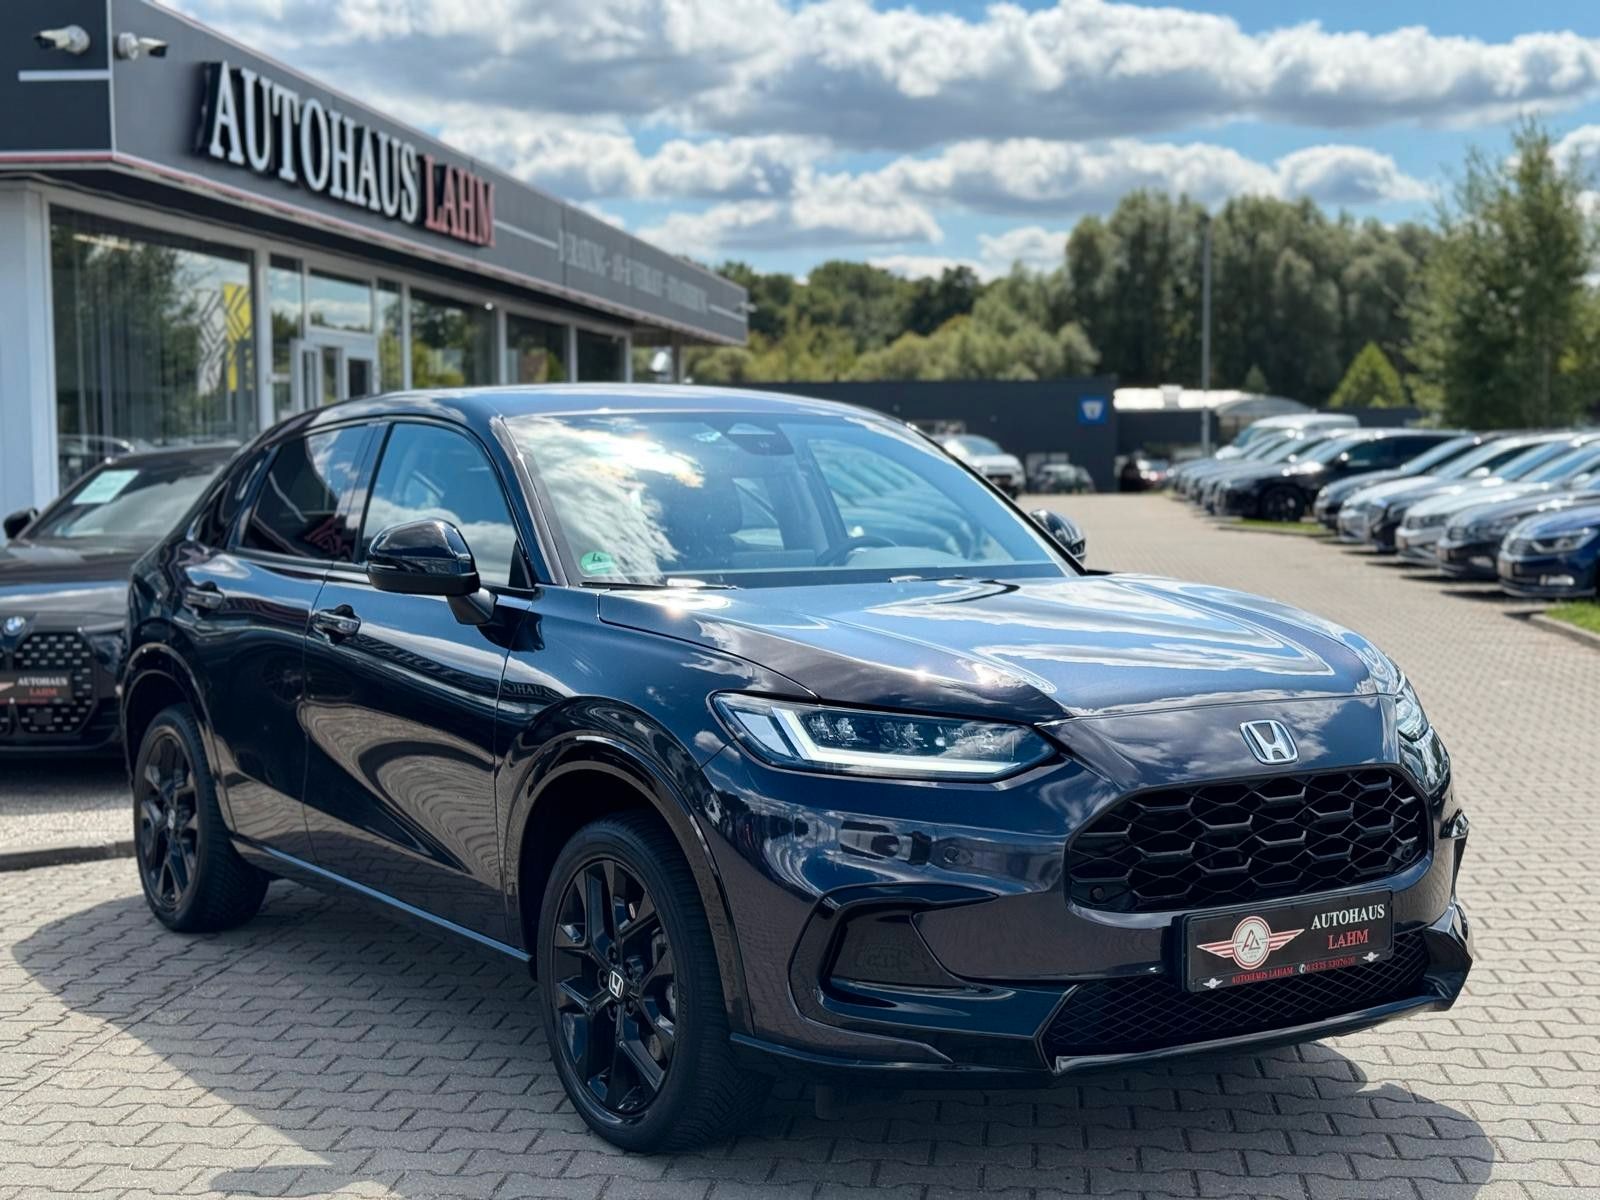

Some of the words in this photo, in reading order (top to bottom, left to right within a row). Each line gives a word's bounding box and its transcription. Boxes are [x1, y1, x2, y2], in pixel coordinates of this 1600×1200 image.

[209, 61, 419, 224] AUTOHAUS
[424, 154, 496, 247] LAHM
[1311, 904, 1385, 930] AUTOHAUS
[1328, 929, 1369, 949] LAHM
